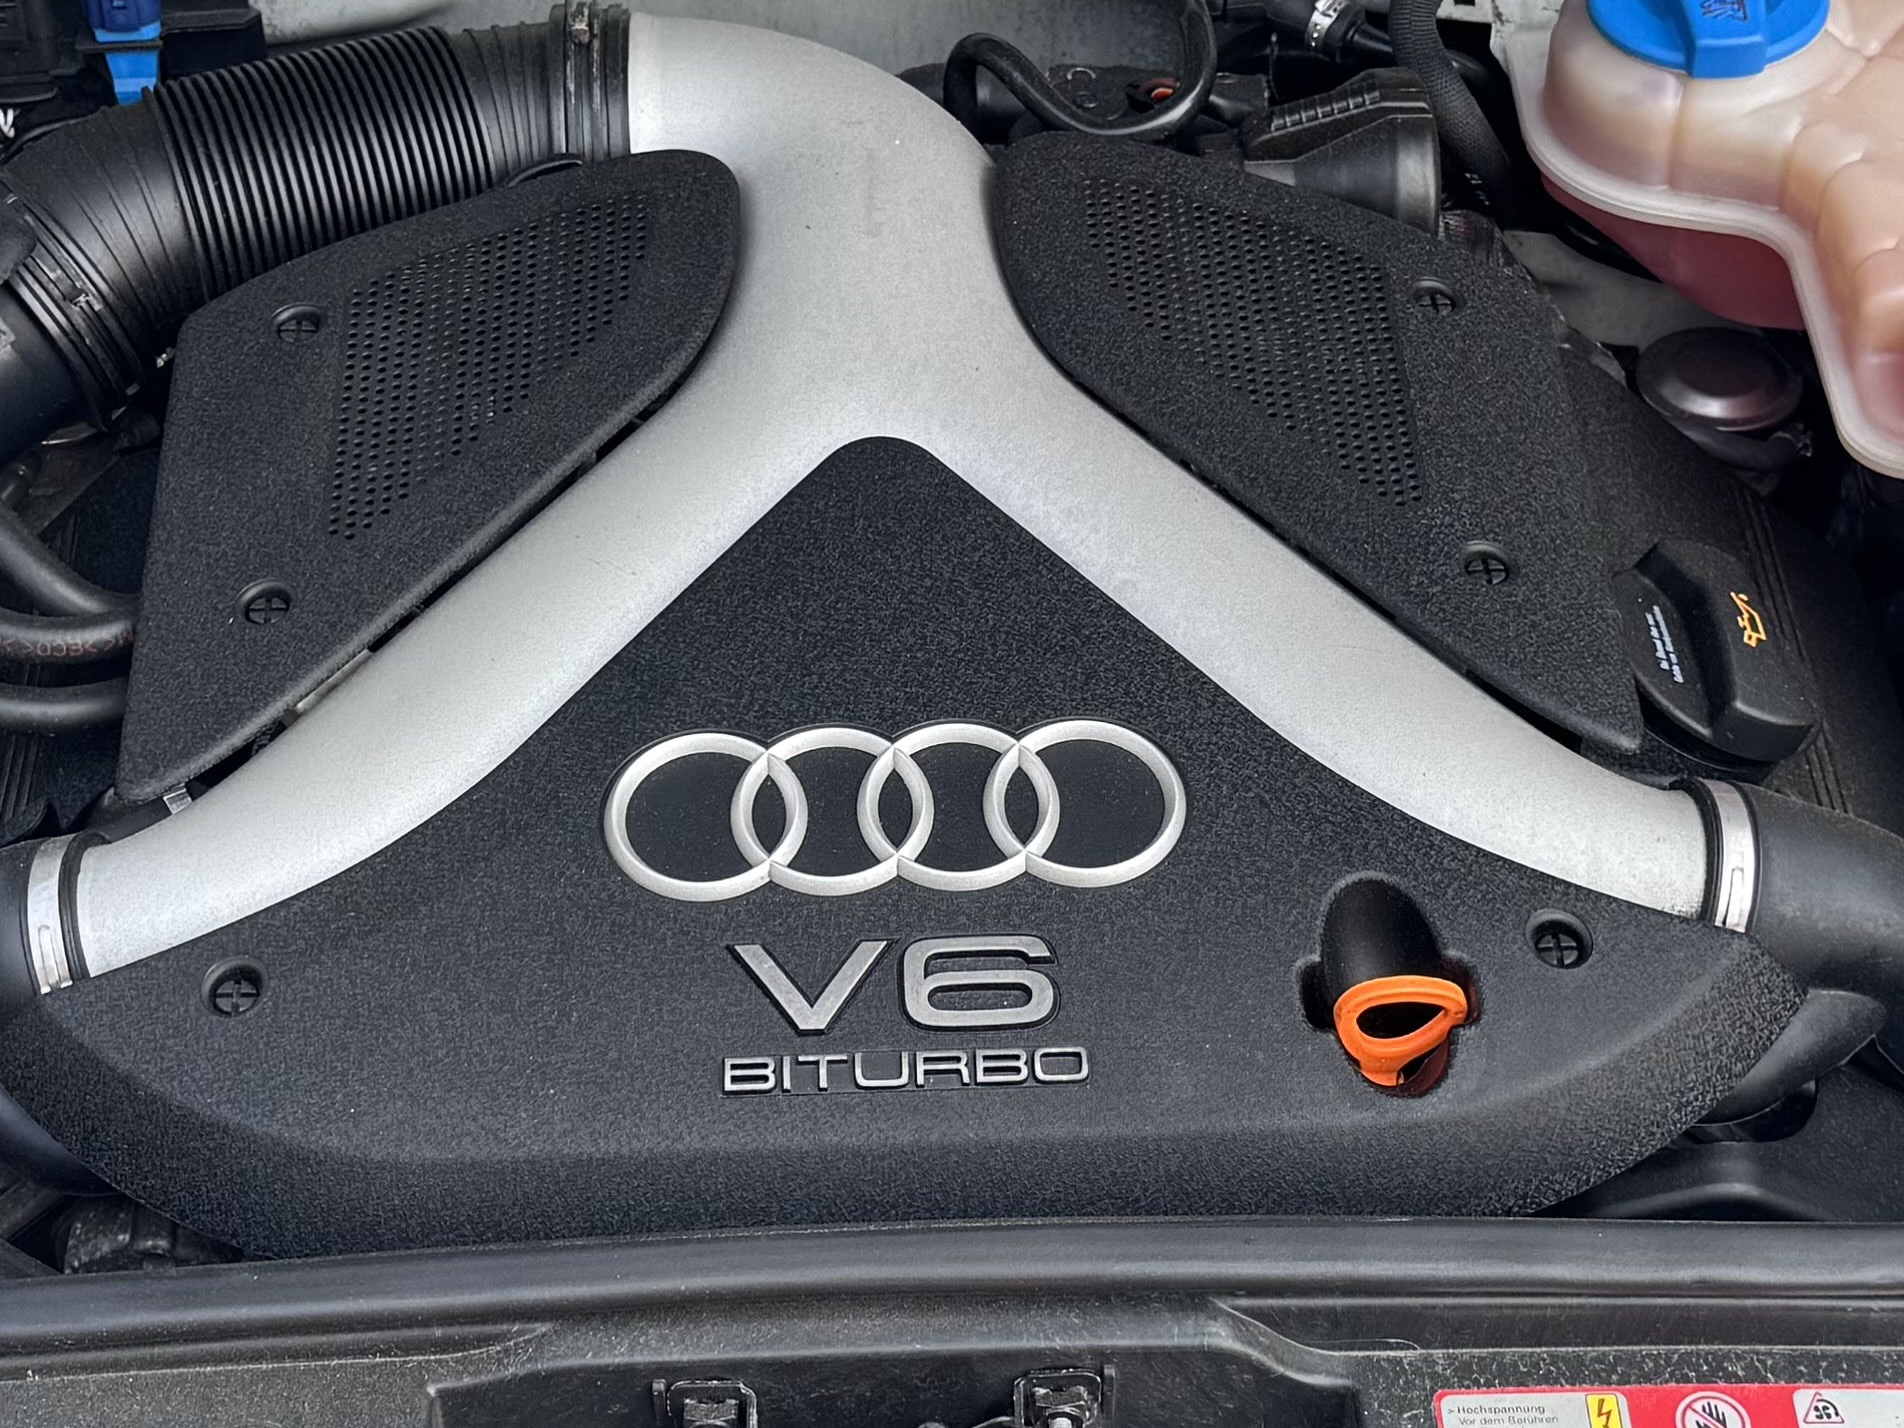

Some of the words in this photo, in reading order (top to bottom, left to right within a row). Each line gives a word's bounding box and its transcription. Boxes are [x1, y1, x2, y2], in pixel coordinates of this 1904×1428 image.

[724, 932, 1061, 1038] V6
[721, 1044, 1091, 1097] BITURBO
[1456, 1404, 1546, 1416] Hochspannung
[1457, 1415, 1476, 1426] Vor
[1478, 1415, 1505, 1425] dem
[1506, 1414, 1559, 1425] Berühren
